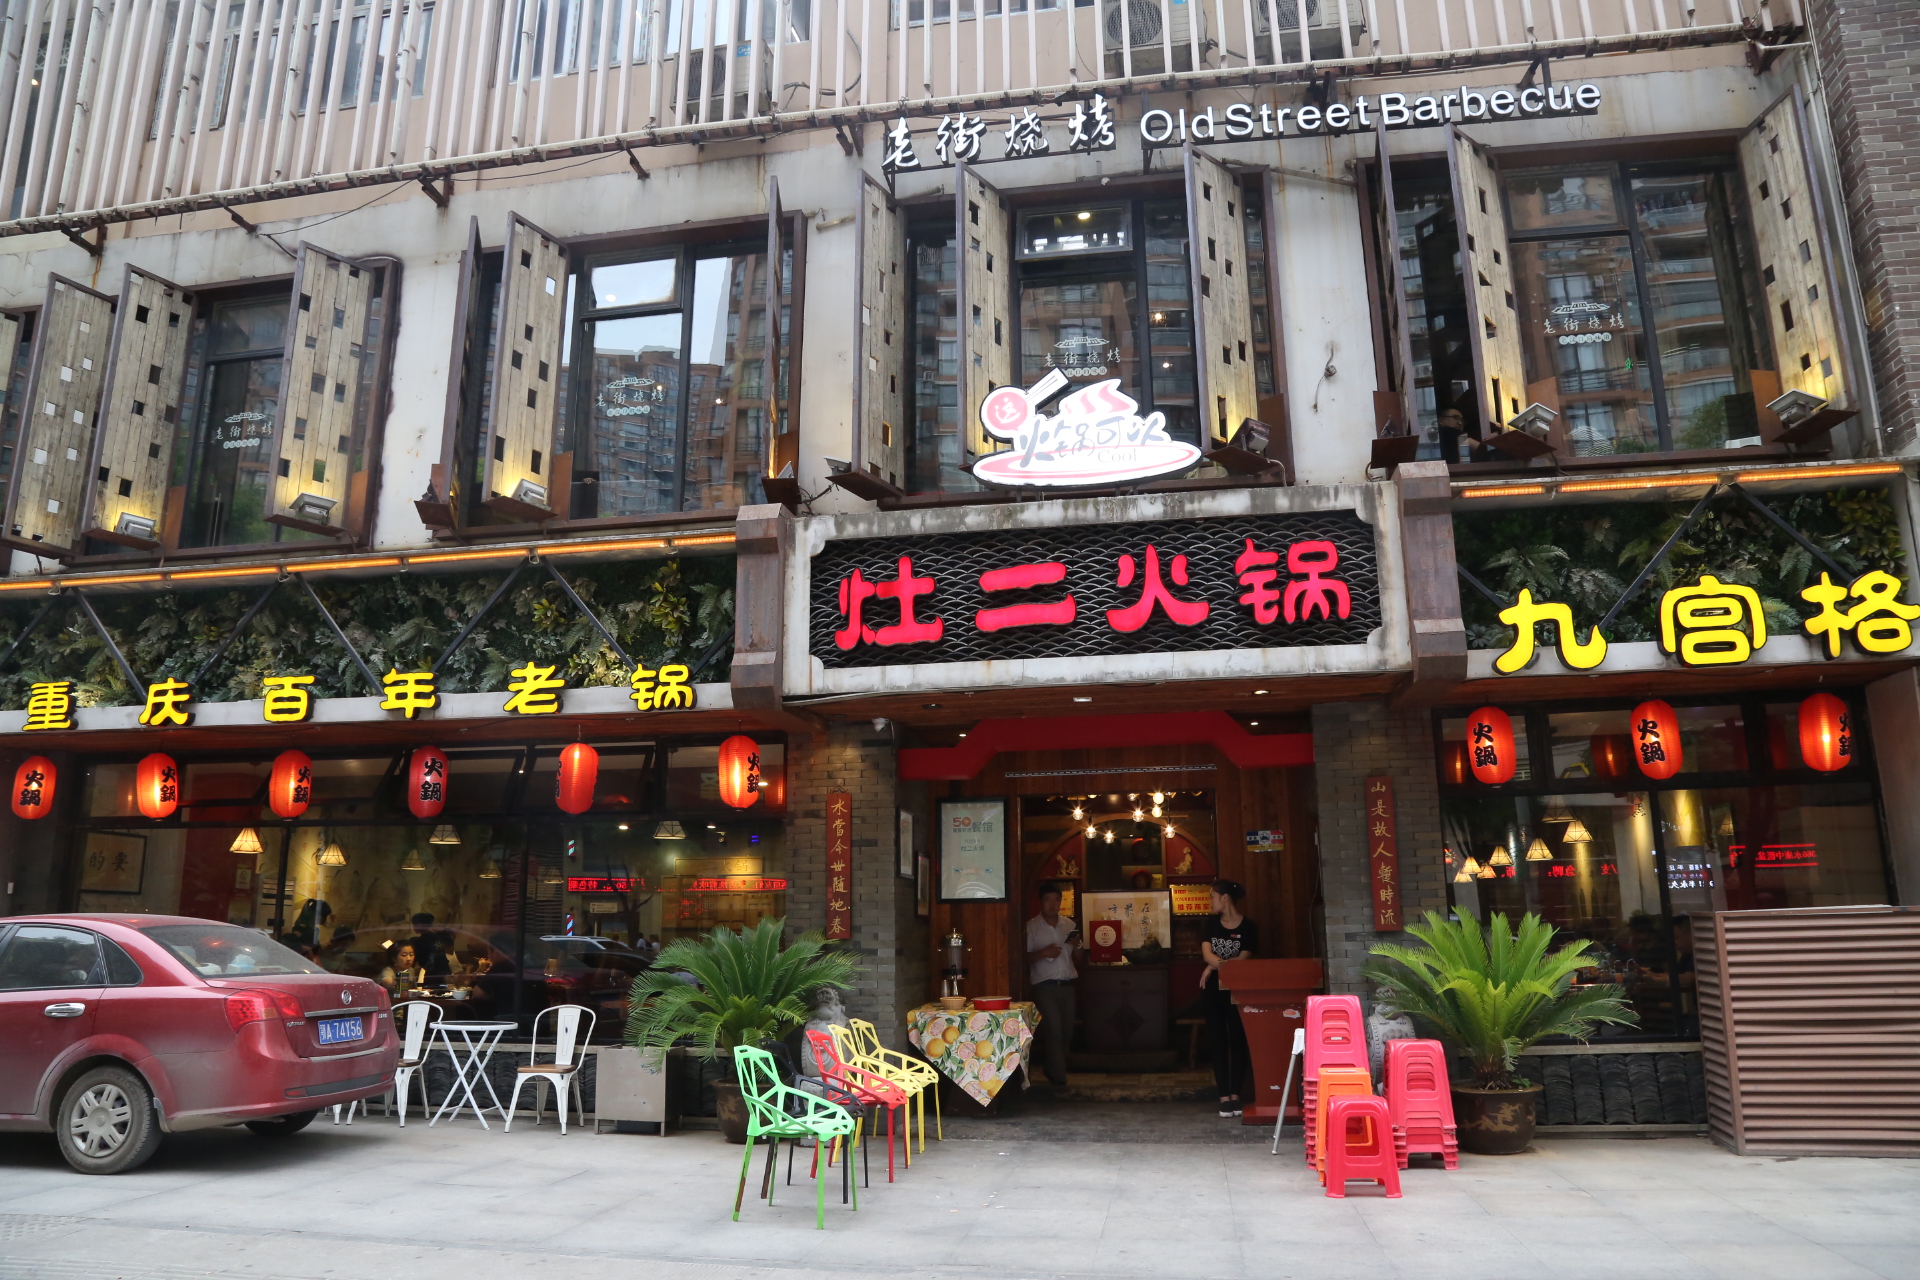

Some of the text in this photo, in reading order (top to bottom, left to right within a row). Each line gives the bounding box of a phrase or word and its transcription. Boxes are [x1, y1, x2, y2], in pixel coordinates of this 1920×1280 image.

[882, 94, 1115, 168] 老街烧烤
[1140, 83, 1601, 142] Old Street Barbecue
[1543, 312, 1625, 334] 老街烧烤
[1043, 346, 1122, 368] 老街烧烤
[596, 387, 667, 407] 老街烧烤
[834, 537, 1351, 652] 灶二火锅
[1494, 570, 1920, 675] 九宫格
[22, 661, 694, 731] 重庆百年老锅
[1472, 722, 1498, 769] 火鍋
[1637, 718, 1666, 766] 火鍋
[19, 769, 45, 808] 火鍋
[160, 765, 177, 803] 火鍋
[292, 765, 312, 804] 火鍋
[419, 757, 444, 803] 火鍋
